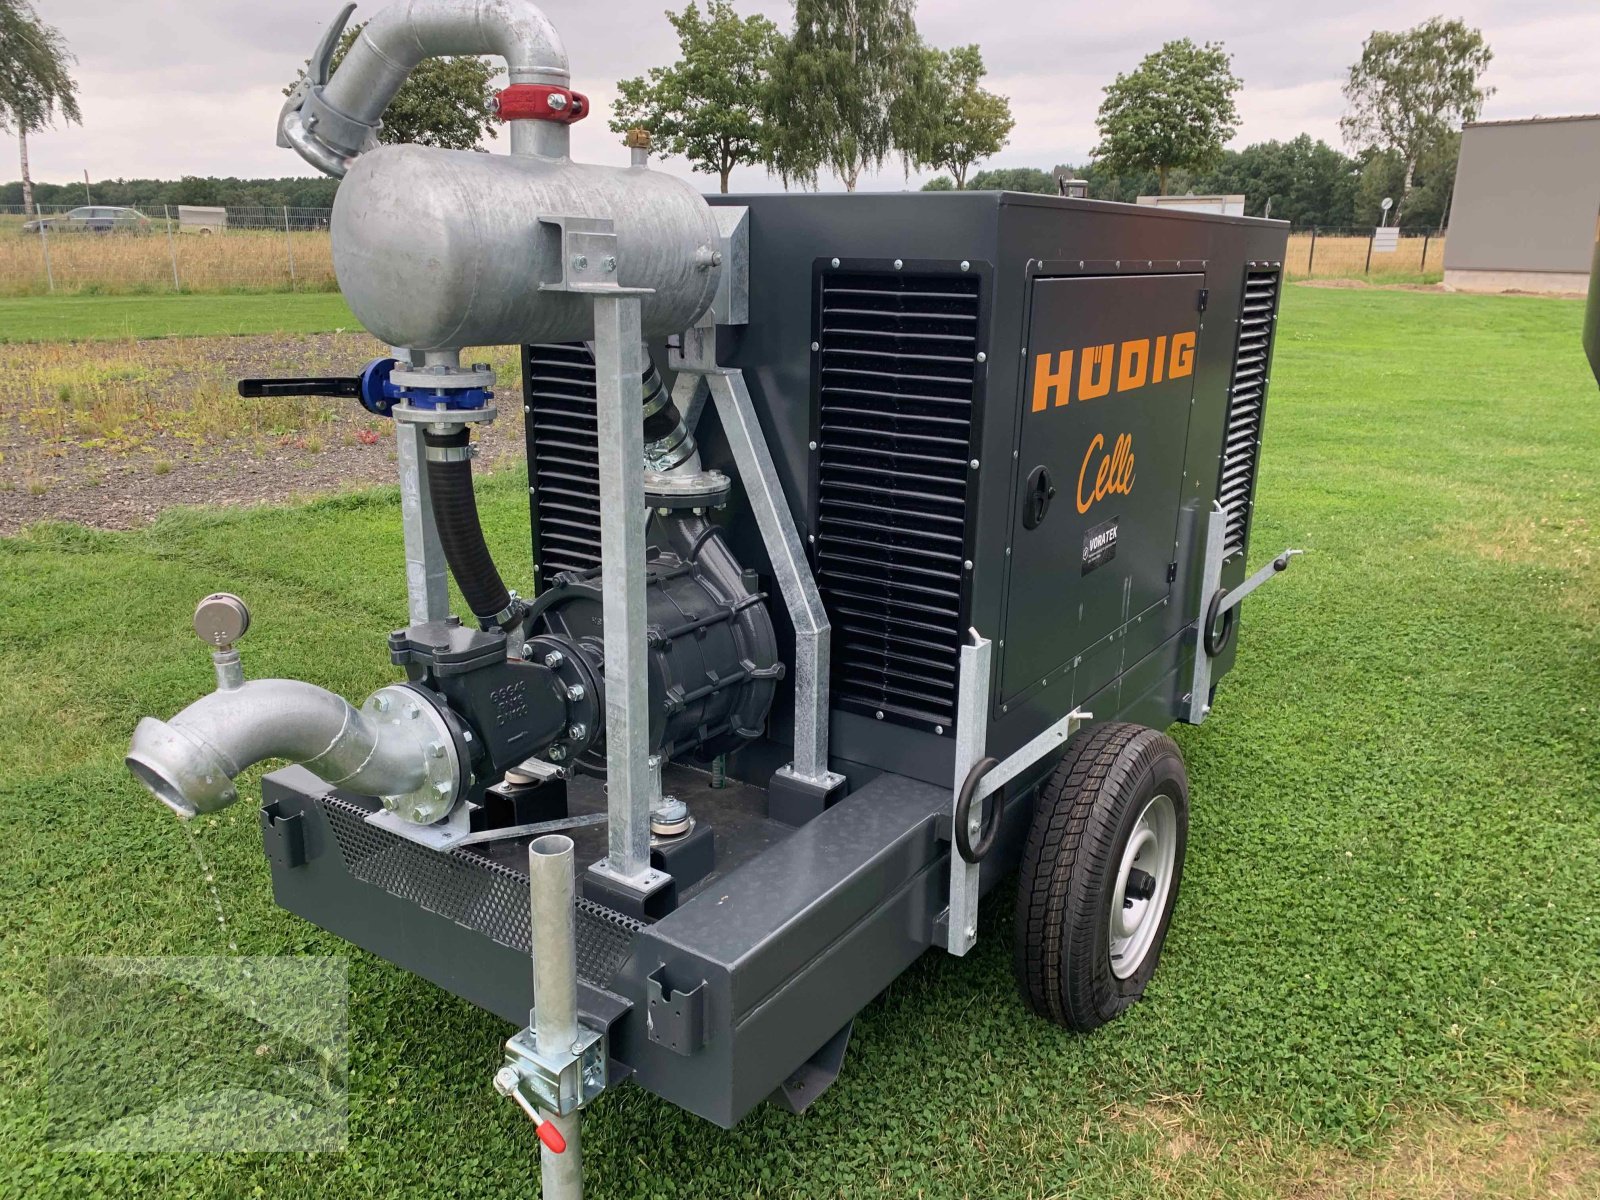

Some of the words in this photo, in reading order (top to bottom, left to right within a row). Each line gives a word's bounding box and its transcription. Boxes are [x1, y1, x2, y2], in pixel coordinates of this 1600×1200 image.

[1032, 331, 1196, 412] HÜDIG
[1076, 433, 1136, 514] Celle
[1089, 525, 1118, 552] VORATEK
